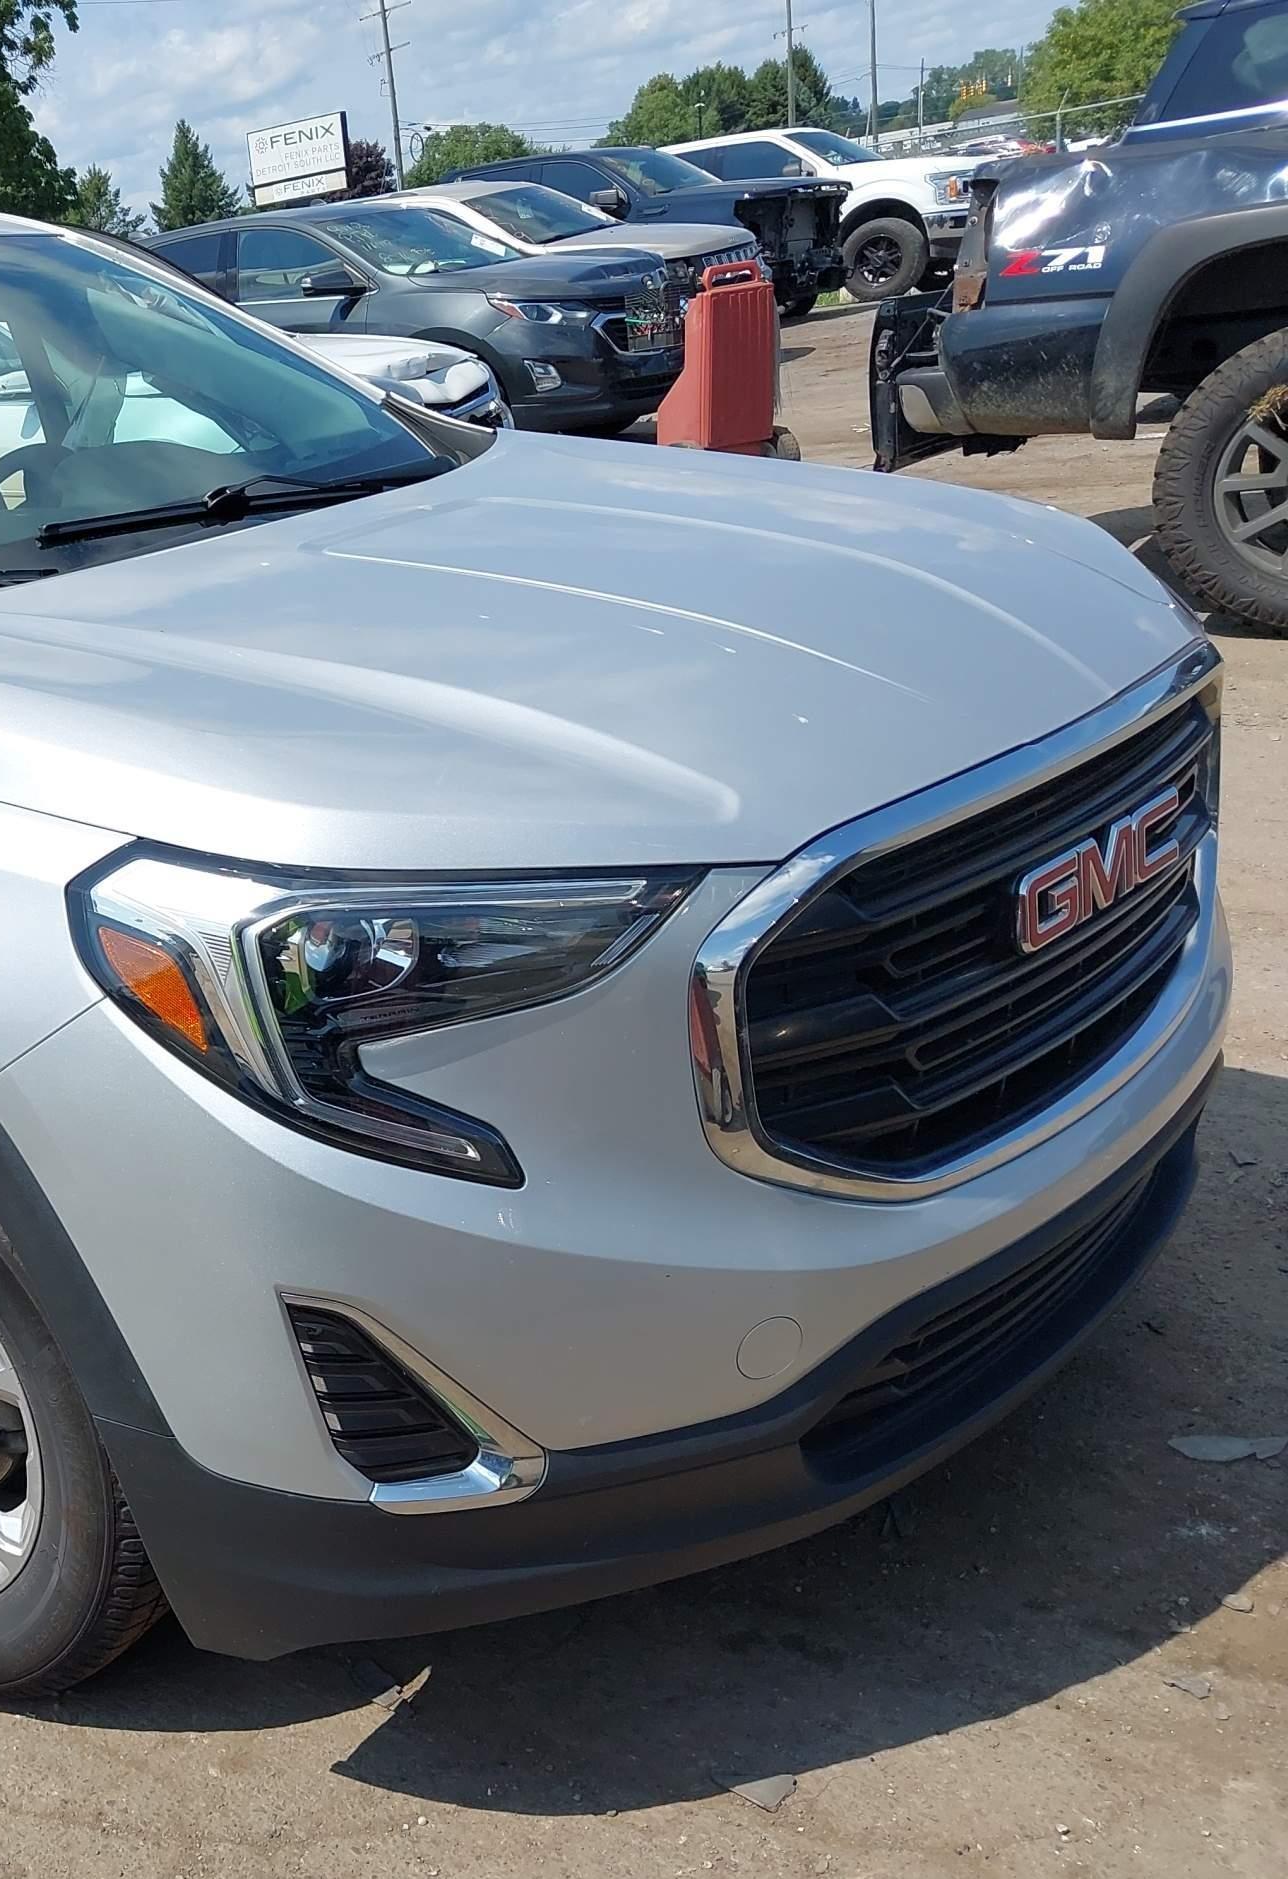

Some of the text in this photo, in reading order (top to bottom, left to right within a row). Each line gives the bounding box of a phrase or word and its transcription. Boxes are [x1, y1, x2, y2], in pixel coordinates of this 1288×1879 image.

[269, 122, 335, 149] FENIX
[255, 151, 341, 177] DETROIT SOUTH LLC
[284, 142, 340, 161] FENIX PARTS
[283, 176, 325, 193] FENIX
[999, 245, 1107, 276] Z71
[1041, 262, 1103, 273] OFF ROAD
[1017, 786, 1179, 953] GMC
